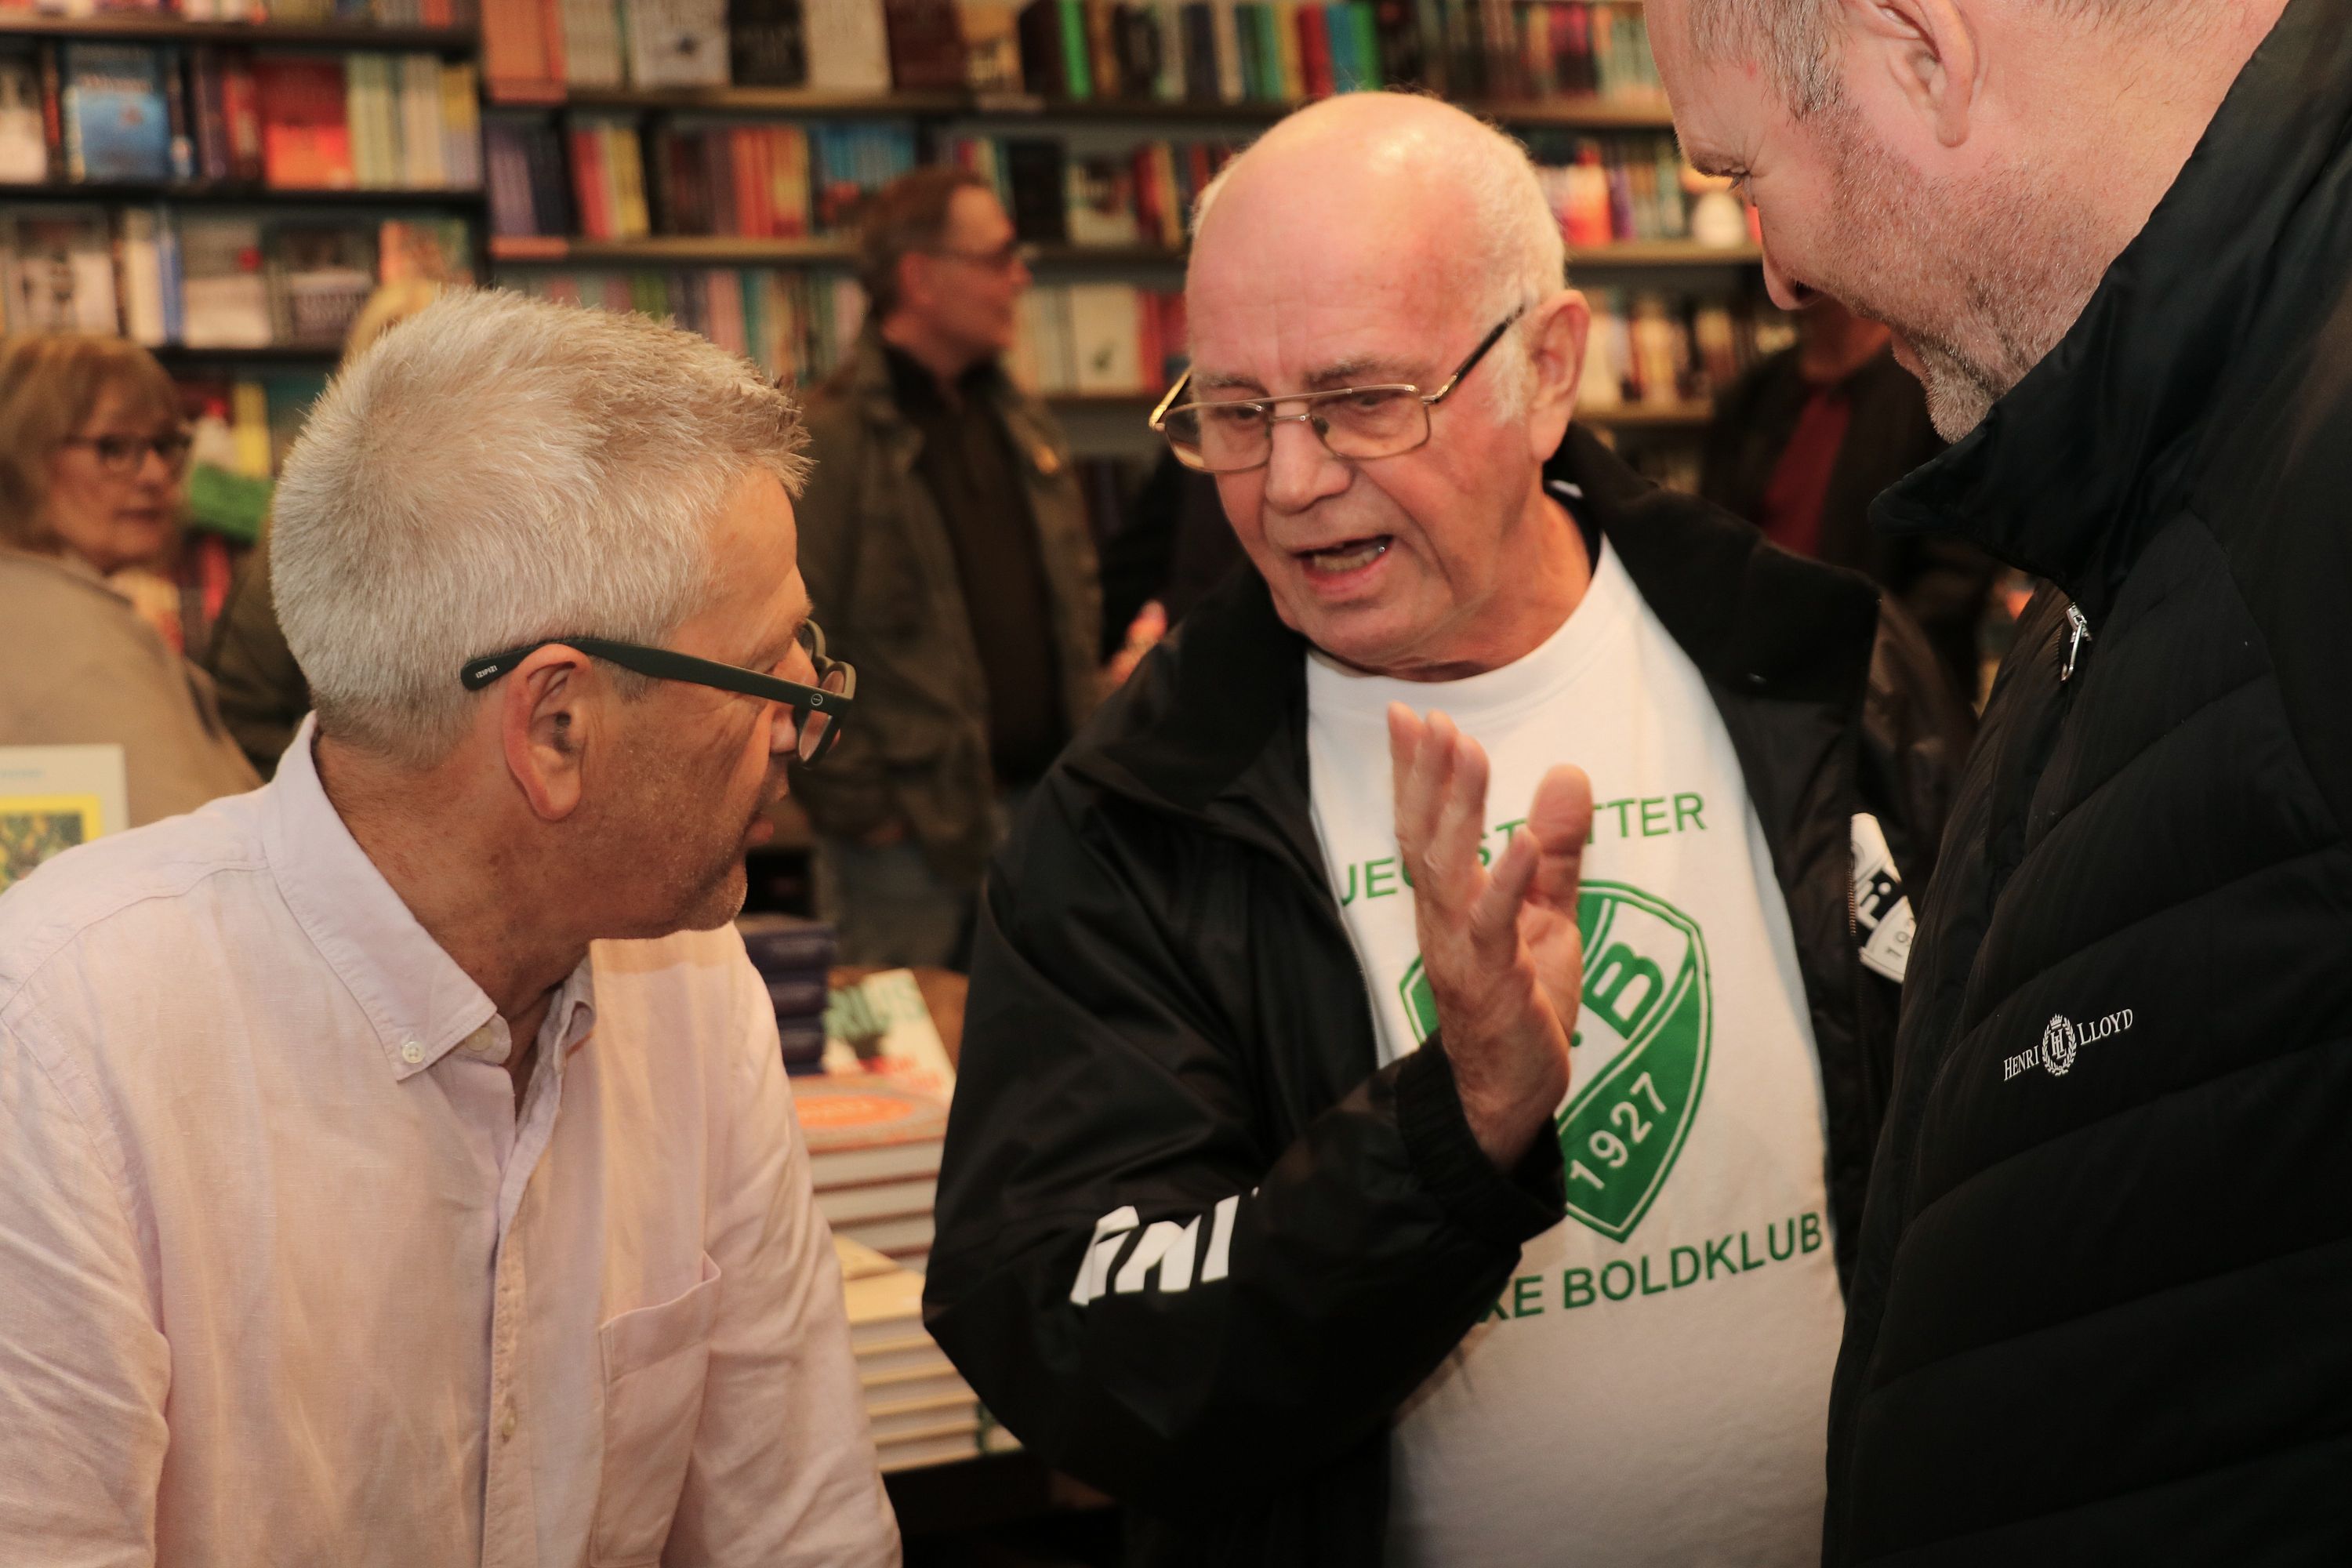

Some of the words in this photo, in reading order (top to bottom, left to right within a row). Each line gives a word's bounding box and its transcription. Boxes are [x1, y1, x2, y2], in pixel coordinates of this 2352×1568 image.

[2003, 1045, 2040, 1082] HENRI
[2077, 1007, 2134, 1046] LLOYD
[1570, 1071, 1668, 1190] 1927
[1563, 1211, 1824, 1309] BOLDKLUB
